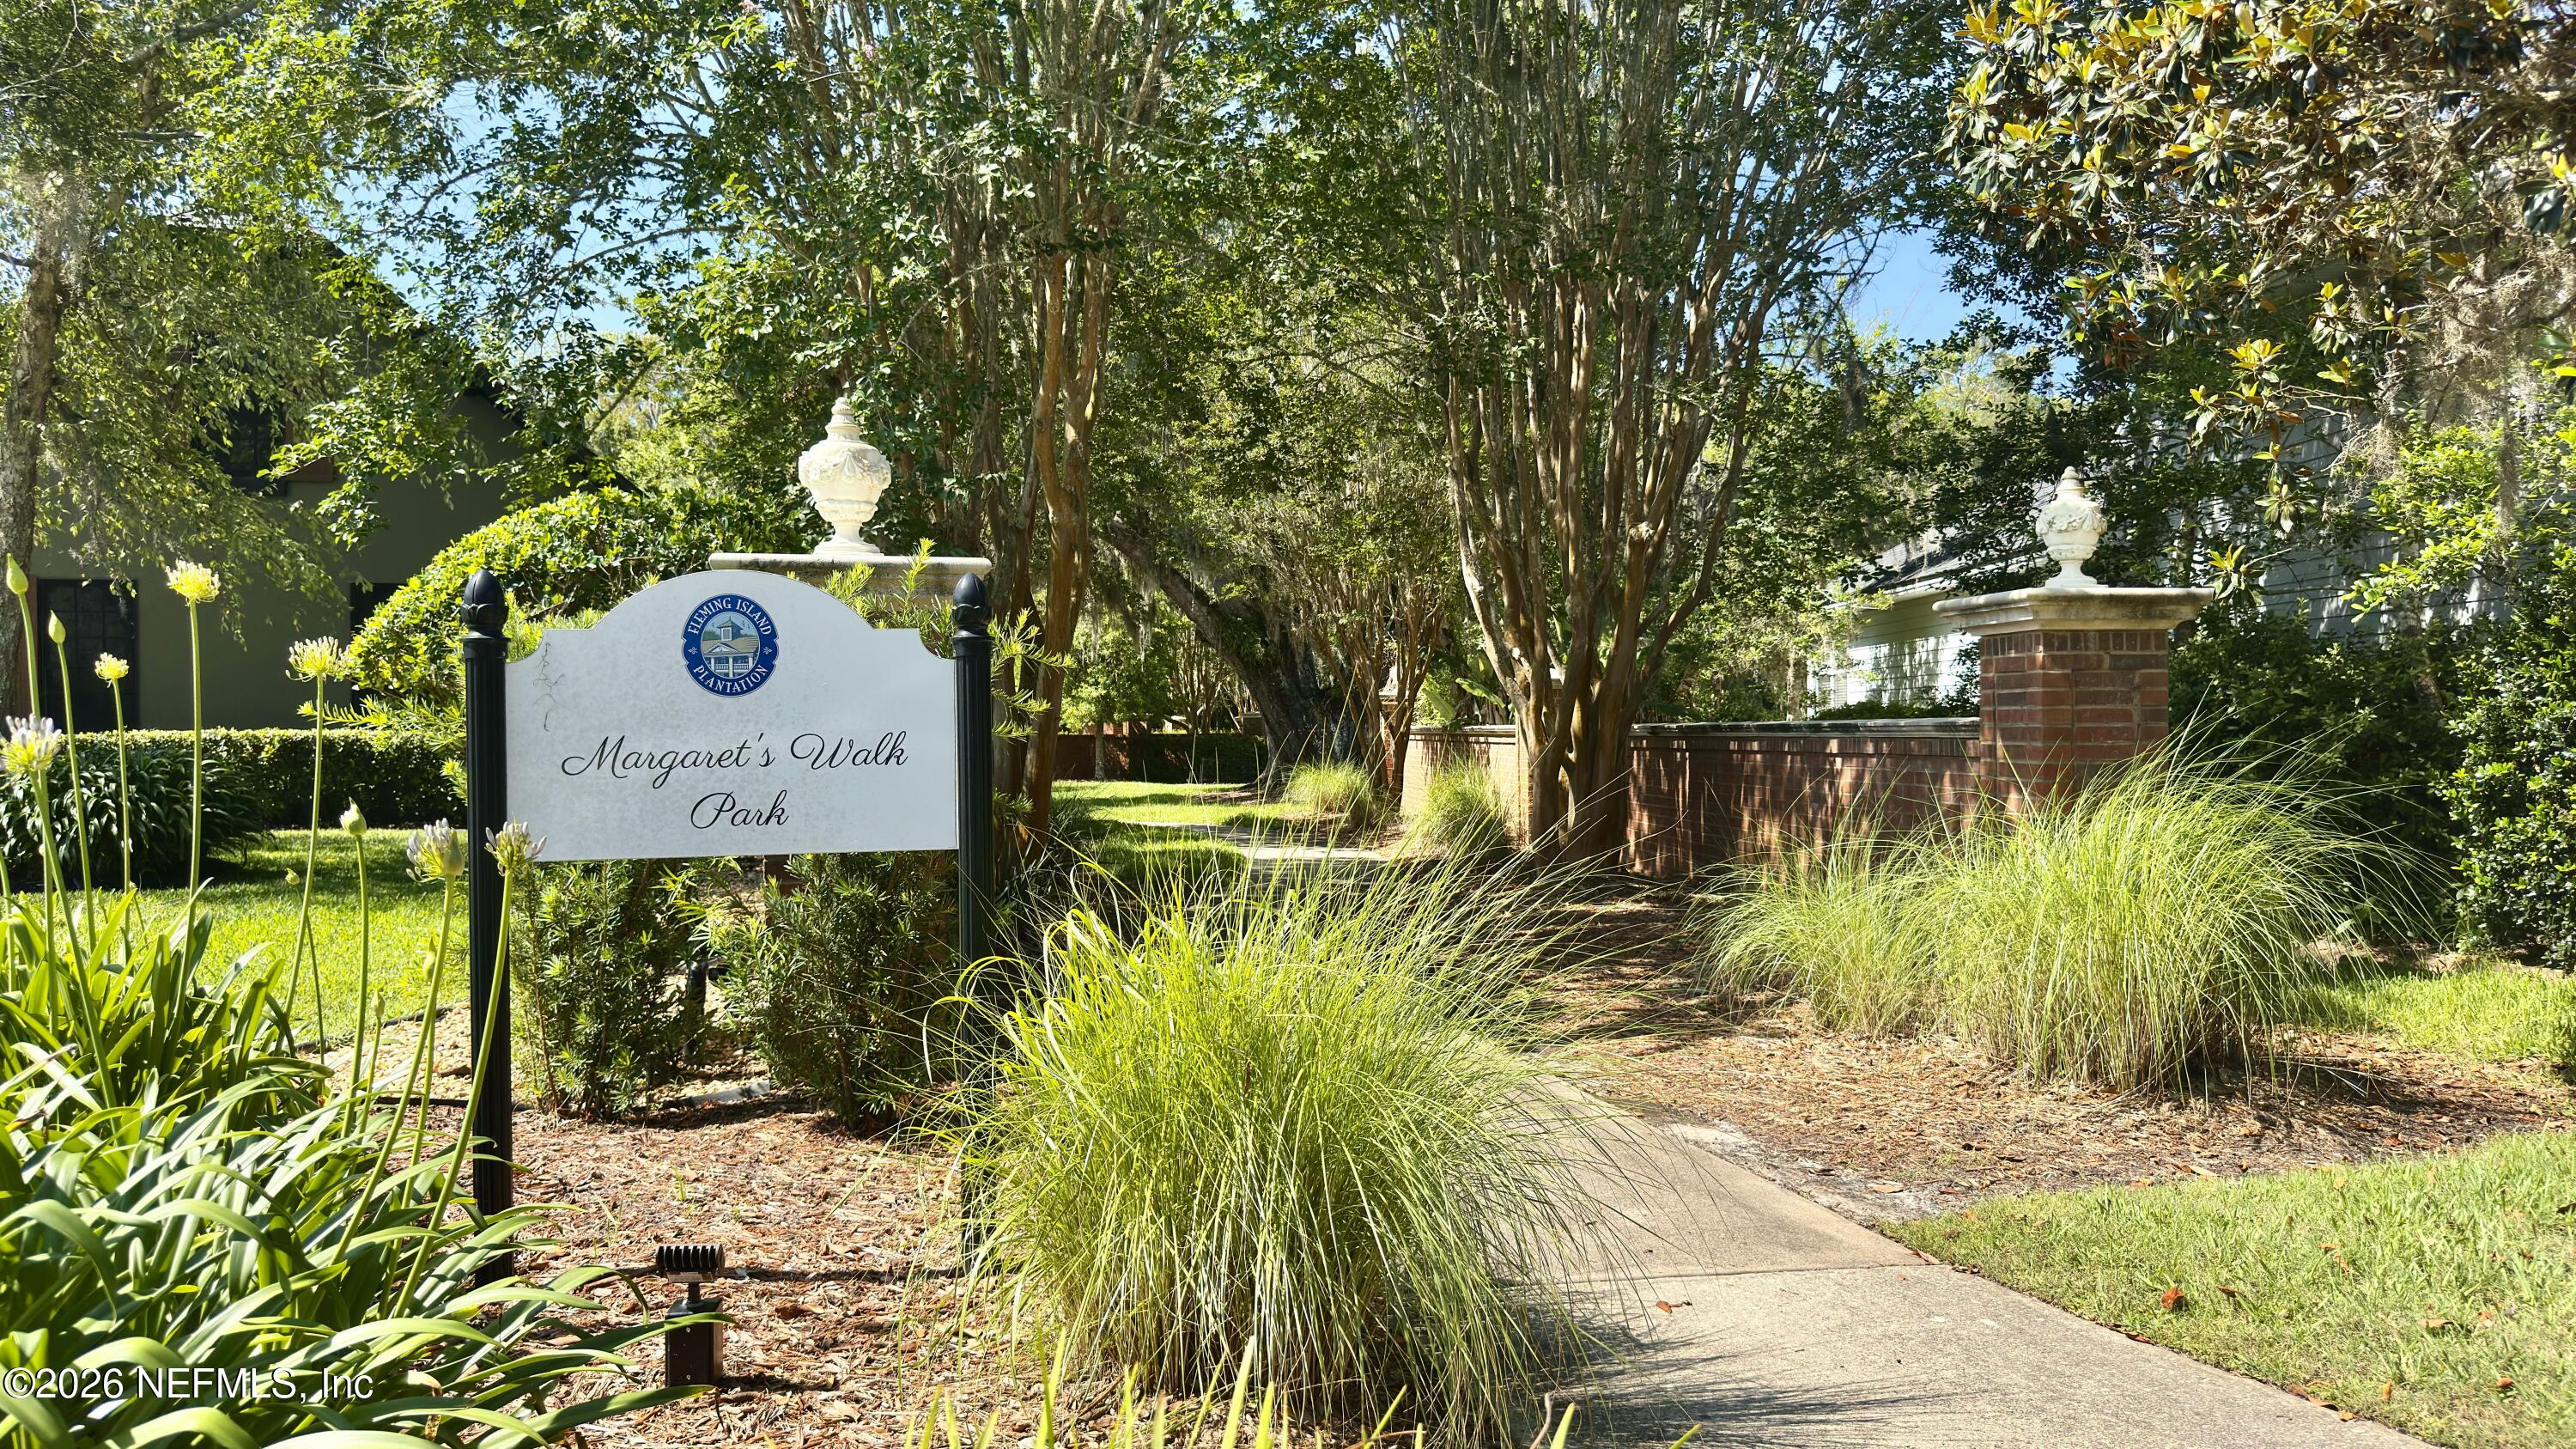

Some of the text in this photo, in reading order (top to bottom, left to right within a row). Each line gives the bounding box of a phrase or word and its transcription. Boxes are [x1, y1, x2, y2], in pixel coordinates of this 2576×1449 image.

[688, 598, 772, 635] FLEMING ISLAND
[694, 665, 769, 692] PLANTATION
[562, 730, 908, 789] Margaret's Walk
[690, 789, 789, 830] Park
